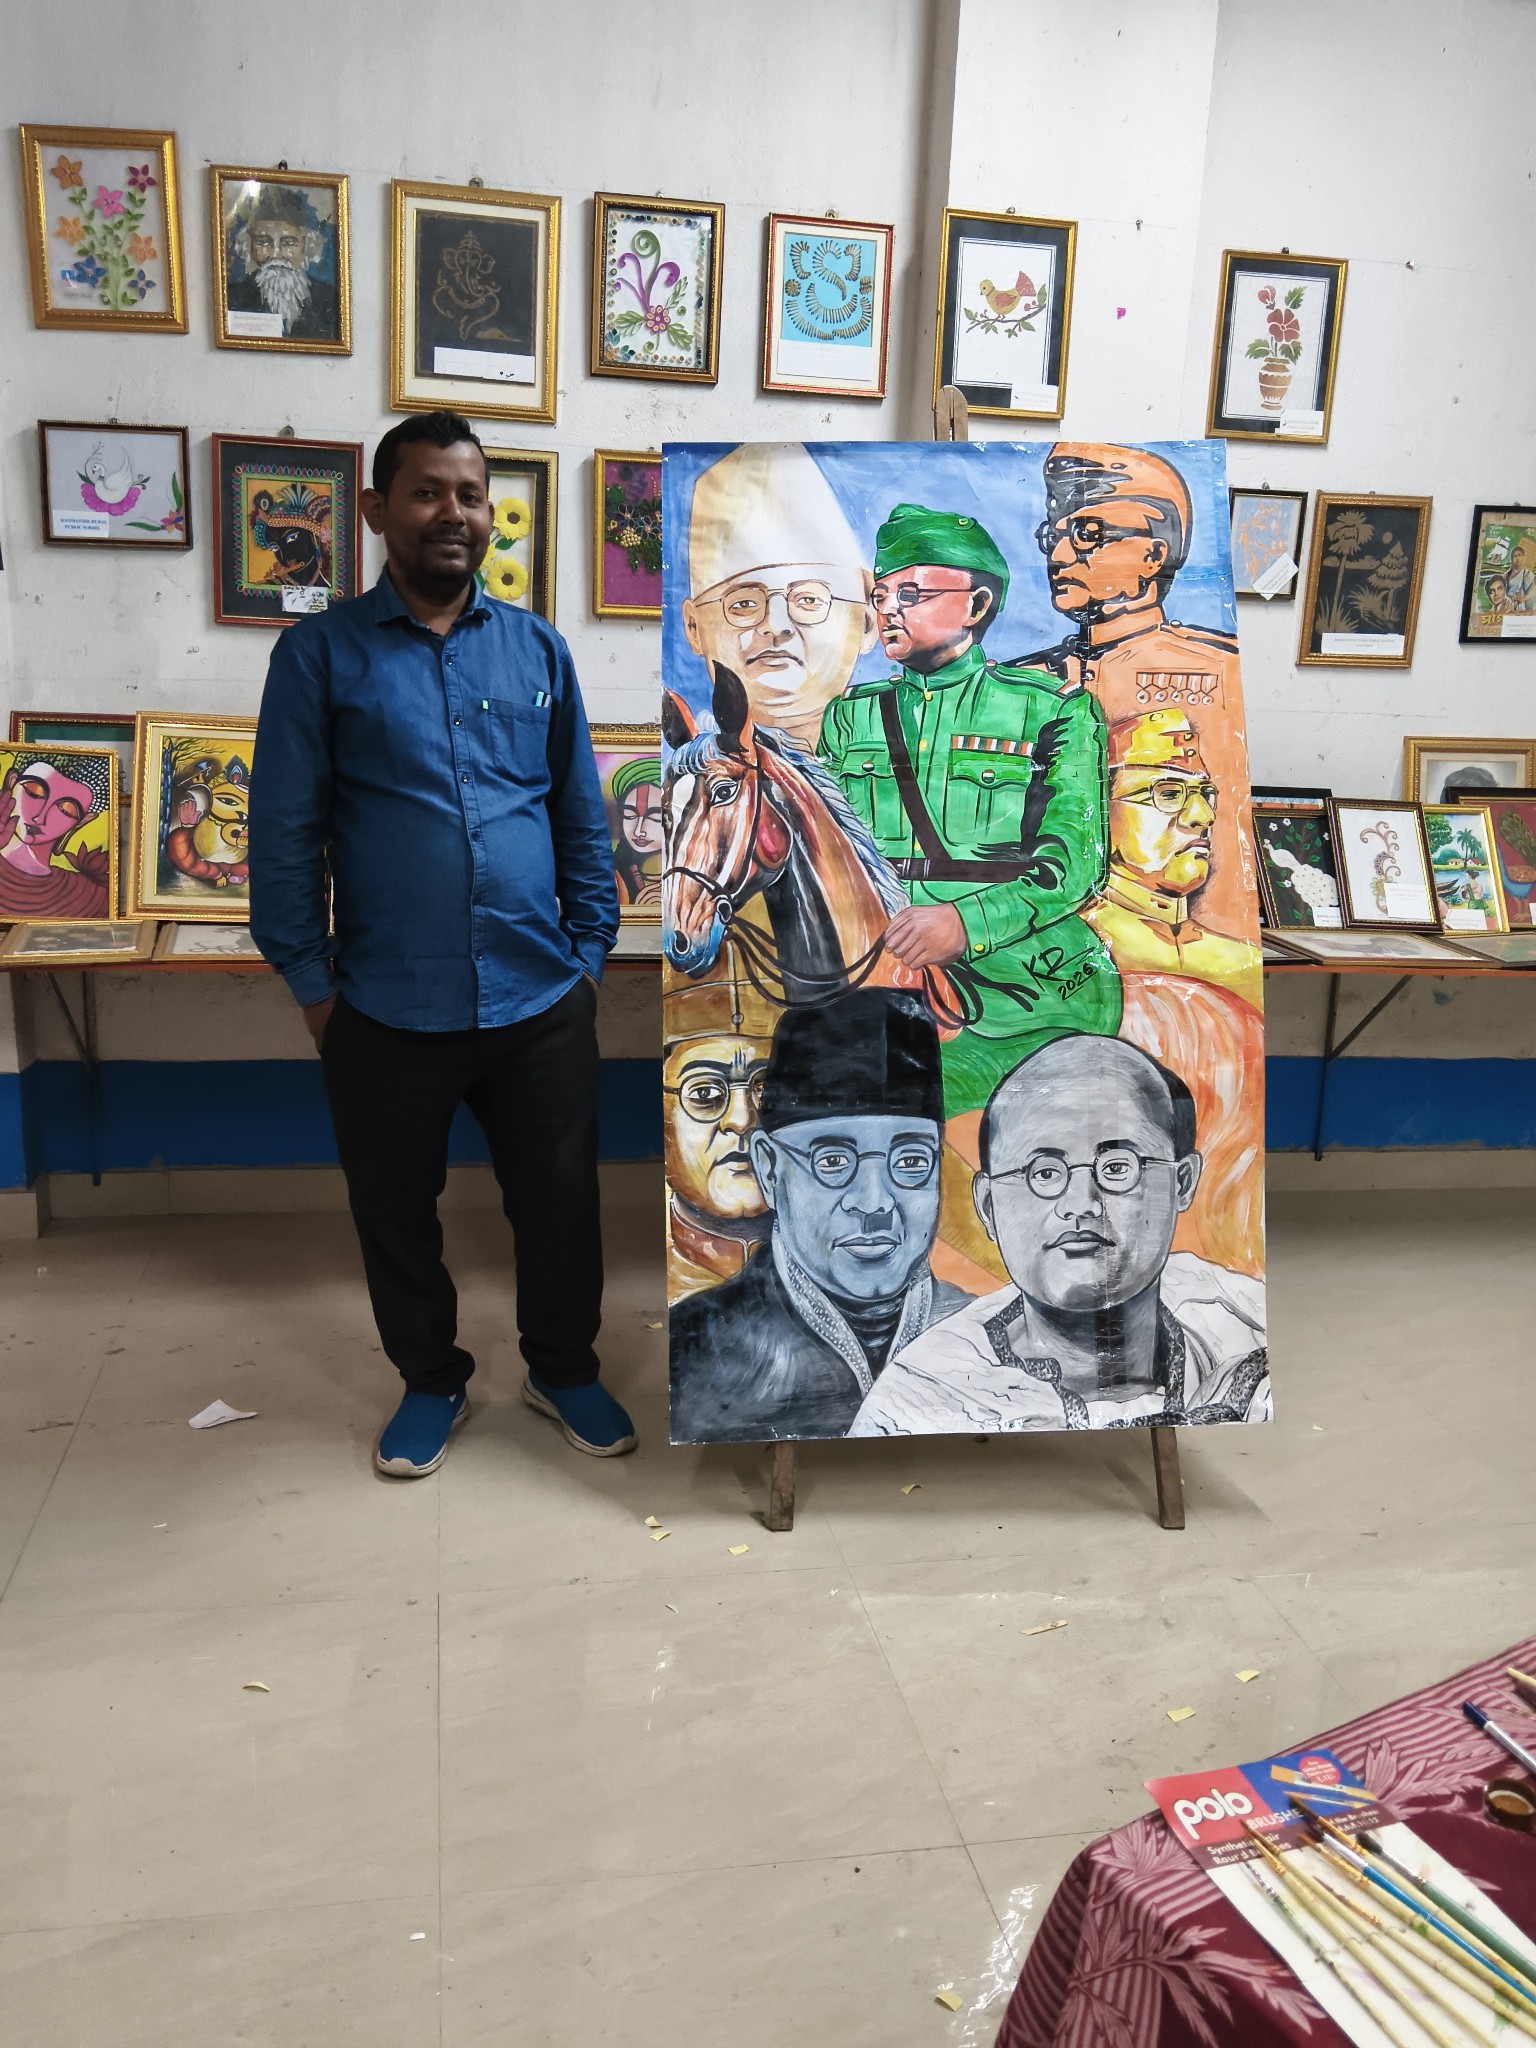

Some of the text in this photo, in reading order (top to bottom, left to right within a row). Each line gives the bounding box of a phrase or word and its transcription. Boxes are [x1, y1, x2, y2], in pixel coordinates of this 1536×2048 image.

[1058, 962, 1098, 1001] 2026
[1173, 1788, 1253, 1840] polo
[1246, 1808, 1304, 1830] BRUSHE
